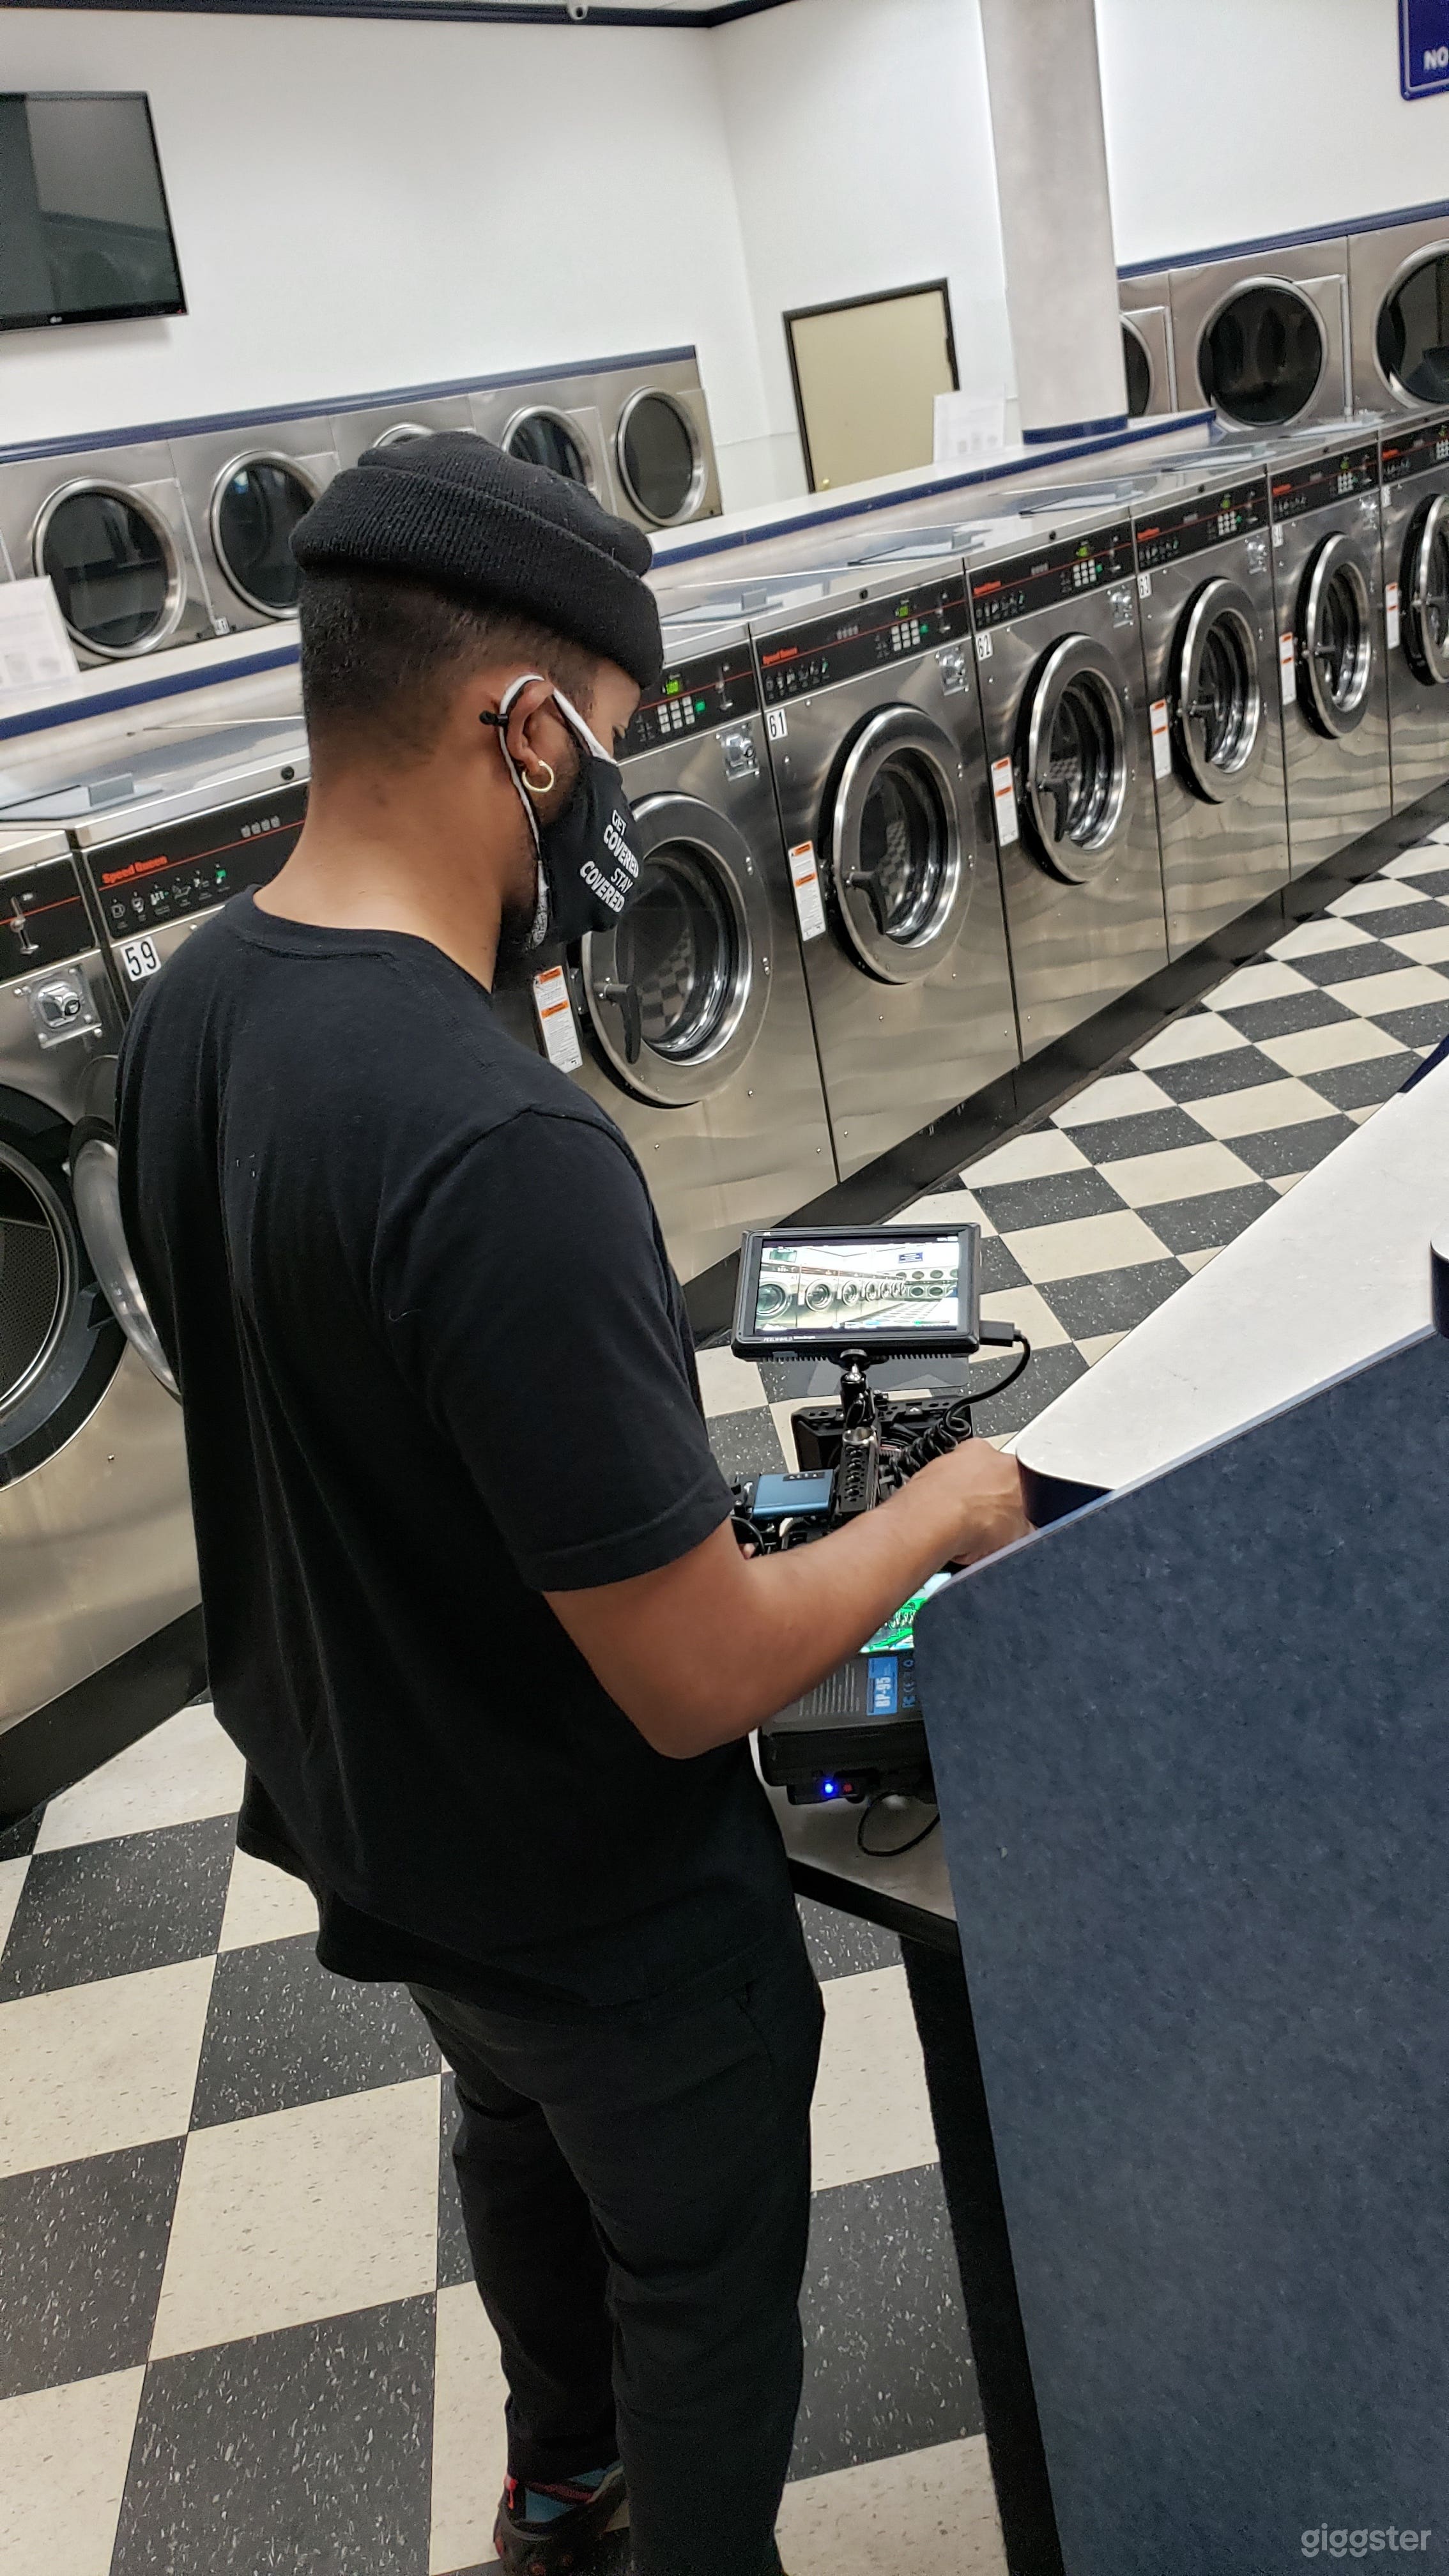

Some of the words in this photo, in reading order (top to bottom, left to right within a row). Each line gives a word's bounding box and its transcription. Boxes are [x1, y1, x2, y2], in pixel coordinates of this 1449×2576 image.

[1424, 46, 1449, 70] NO
[977, 635, 990, 657] 62
[769, 712, 785, 737] 61
[611, 809, 627, 836] GET
[603, 824, 638, 878] COVERED
[102, 864, 135, 883] Speed
[135, 856, 167, 872] Queen
[610, 868, 633, 893] STAY
[579, 861, 625, 912] COVERED
[125, 941, 157, 976] 59
[875, 1676, 891, 1708] BP-95
